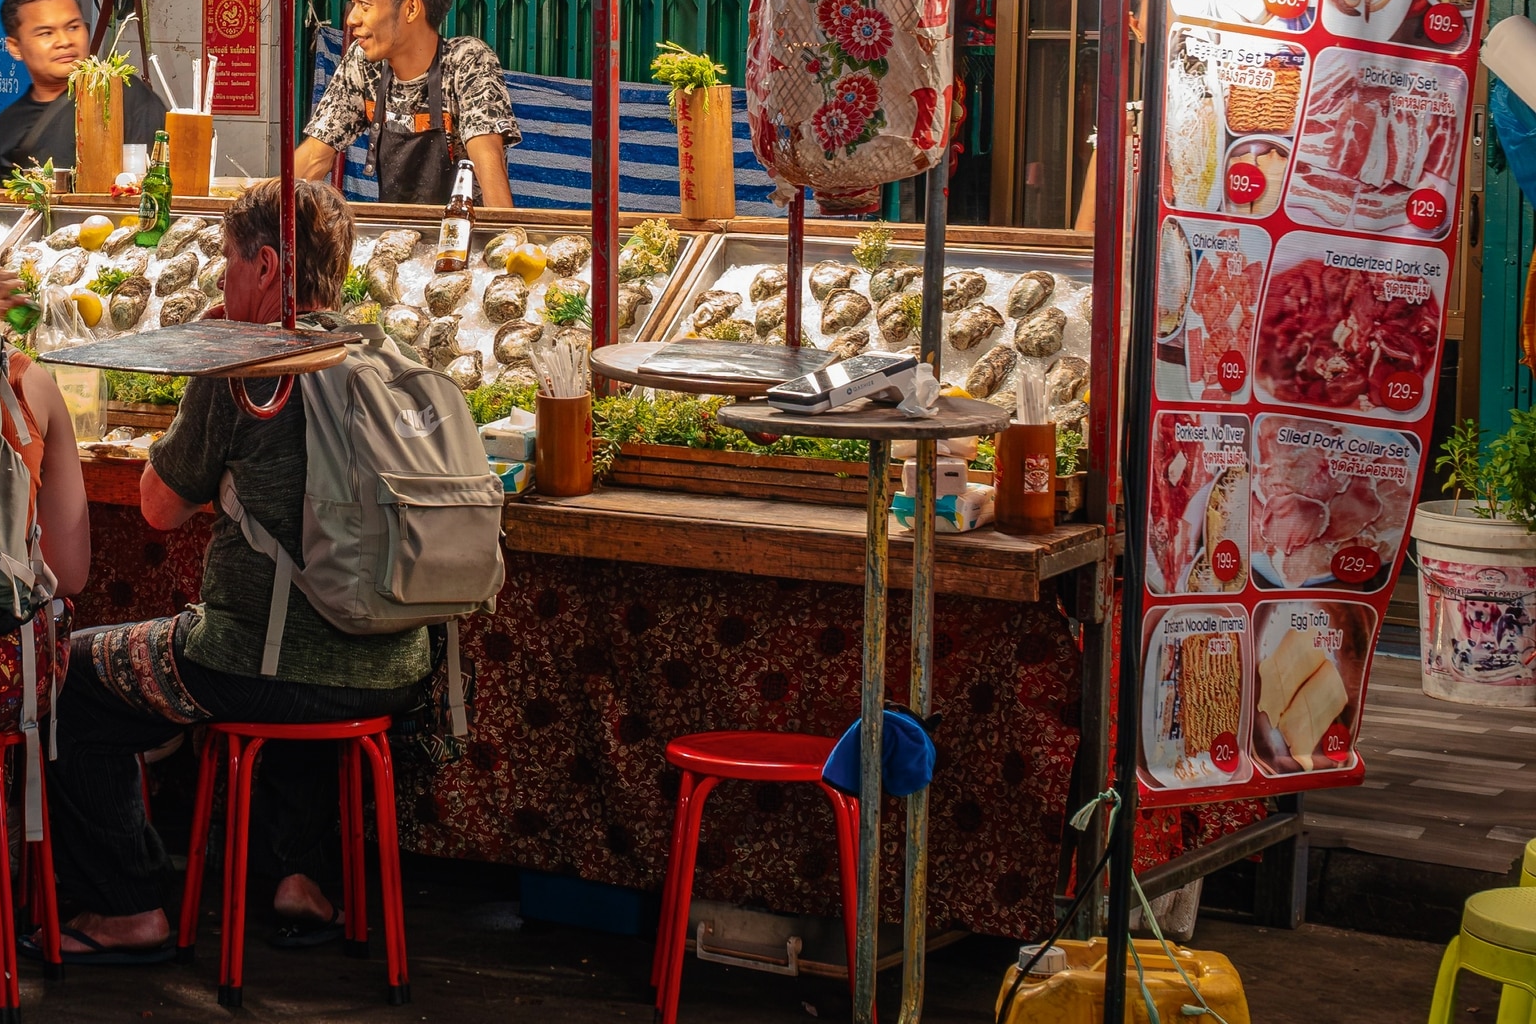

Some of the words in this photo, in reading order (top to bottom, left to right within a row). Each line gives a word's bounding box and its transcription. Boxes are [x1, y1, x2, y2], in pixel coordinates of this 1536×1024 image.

[1429, 13, 1459, 33] 199.-
[1237, 49, 1263, 65] Set
[1364, 68, 1388, 84] Pork
[1389, 71, 1415, 91] belly
[1417, 76, 1438, 91] Set
[1390, 93, 1456, 116] ชุดหมูสามชั้น
[1229, 174, 1260, 193] 199.-
[1411, 199, 1443, 218] 129.-
[1192, 233, 1227, 251] Chicken
[1325, 251, 1393, 272] Tenderized
[1395, 259, 1420, 274] Pork
[1423, 263, 1441, 277] Set
[1221, 362, 1244, 379] 199.-
[1387, 382, 1419, 400] 129.-
[1176, 425, 1192, 440] Pork
[1212, 427, 1224, 440] No
[1225, 427, 1244, 441] liver
[1312, 433, 1345, 450] Pork
[1348, 439, 1386, 455] Collar
[1388, 444, 1410, 457] Set
[1215, 552, 1237, 569] 199.-
[1339, 555, 1374, 572] 129.-
[1163, 619, 1185, 634] Instant
[1185, 617, 1217, 632] Noodle
[1218, 616, 1246, 633] (mama)
[1290, 613, 1308, 628] Egg
[1309, 613, 1329, 627] Tofu
[1215, 744, 1235, 761] 20.-
[1327, 735, 1345, 752] 20.-
